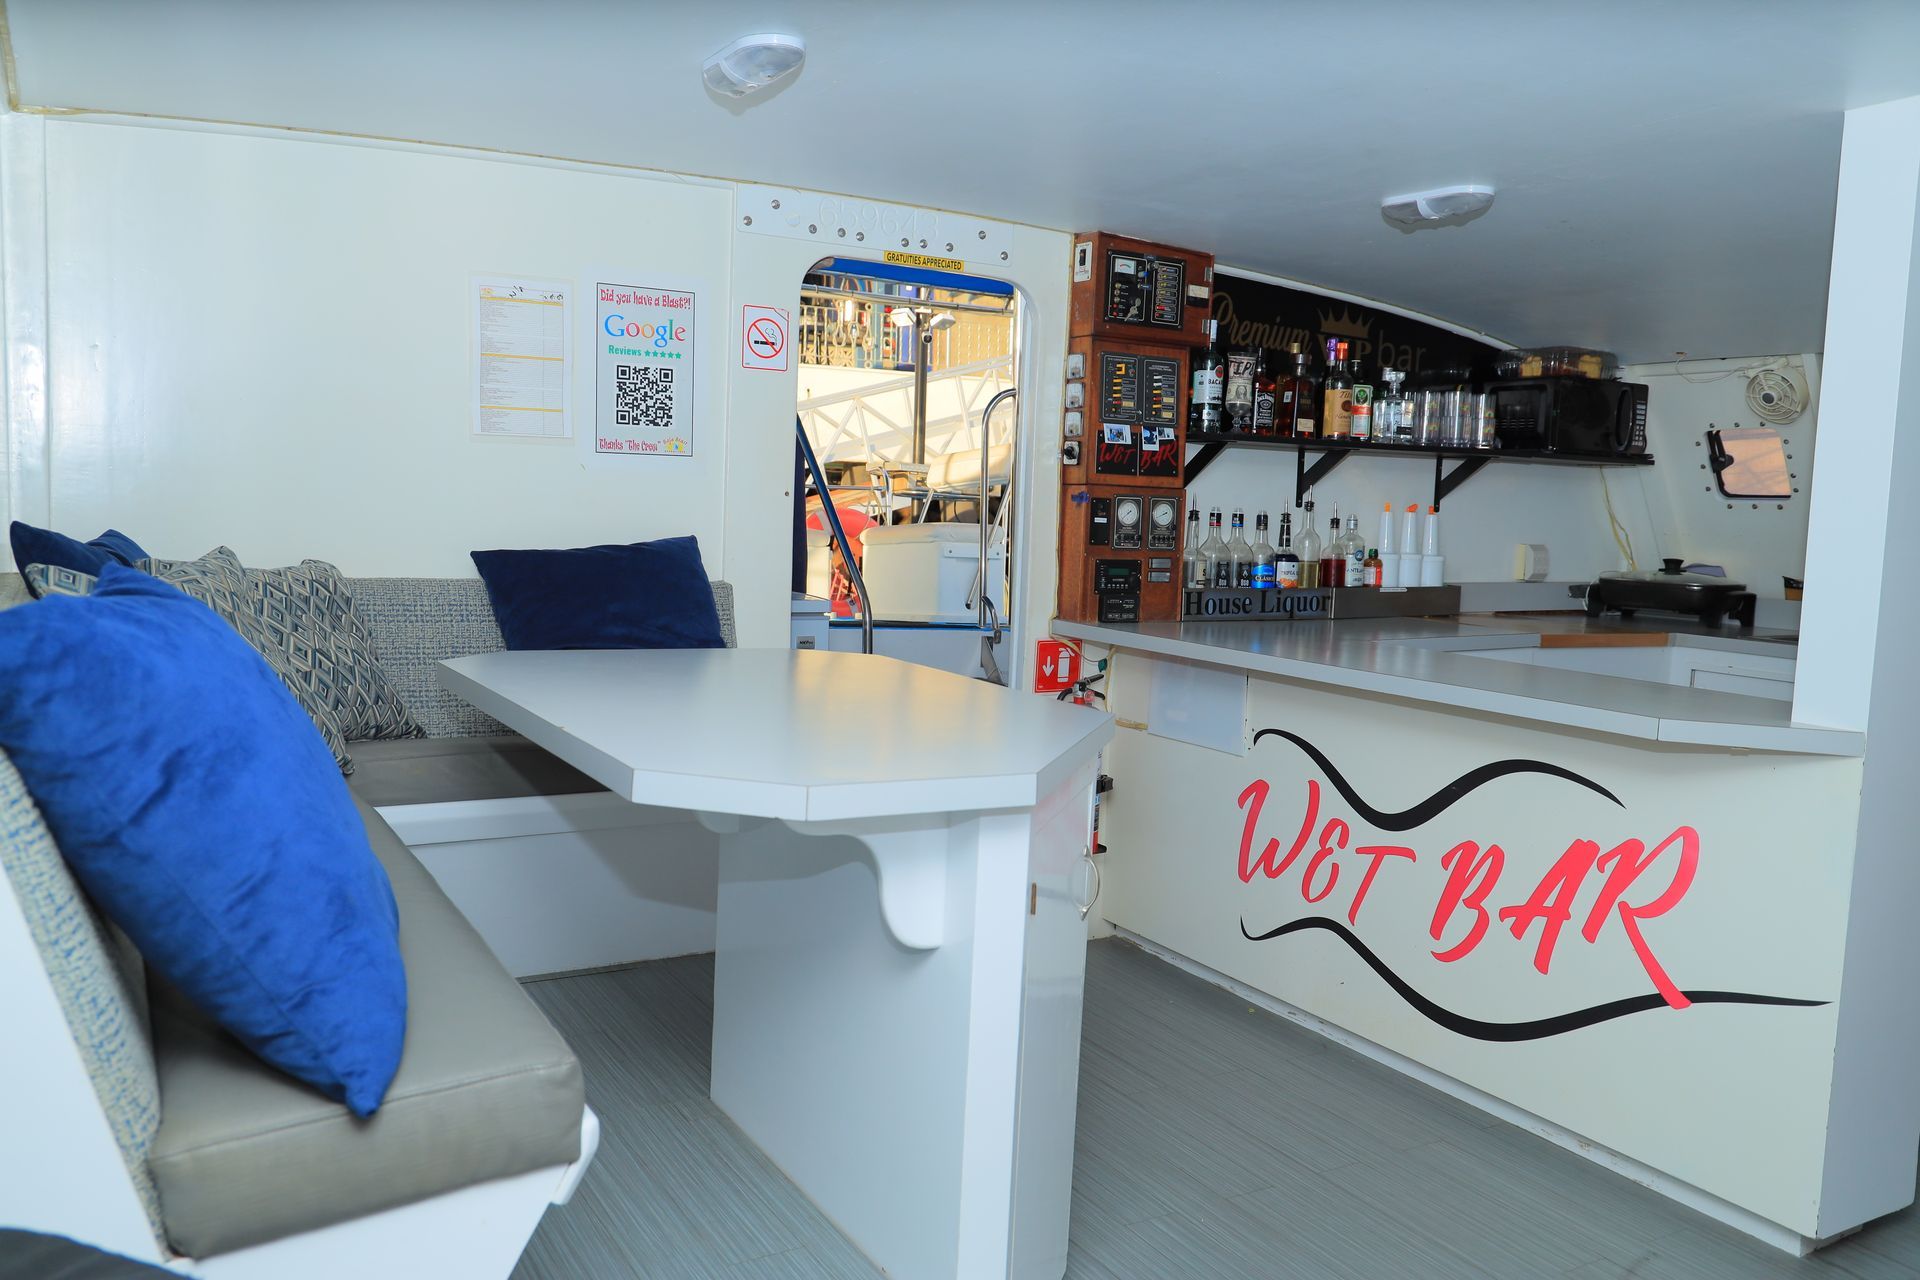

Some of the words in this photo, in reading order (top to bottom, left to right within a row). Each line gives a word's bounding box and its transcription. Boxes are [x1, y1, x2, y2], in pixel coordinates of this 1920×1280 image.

[886, 252, 921, 266] GRATUITIES
[921, 257, 962, 271] APPRECIATED
[600, 288, 614, 302] Did
[616, 293, 631, 306] you
[633, 291, 653, 306] have
[654, 296, 660, 307] a
[661, 294, 691, 310] Blast?!
[604, 314, 687, 348] Google
[1213, 291, 1313, 354] Premium
[1317, 333, 1373, 361] VP
[1377, 328, 1426, 373] bar
[608, 344, 642, 357] Reviews
[599, 438, 624, 450] Thanks
[1099, 442, 1137, 465] WET
[1140, 439, 1178, 470] BAR
[1184, 590, 1253, 617] House
[1260, 589, 1331, 619] Liquor
[1237, 779, 1416, 927] WET
[1429, 825, 1700, 1010] BAR
